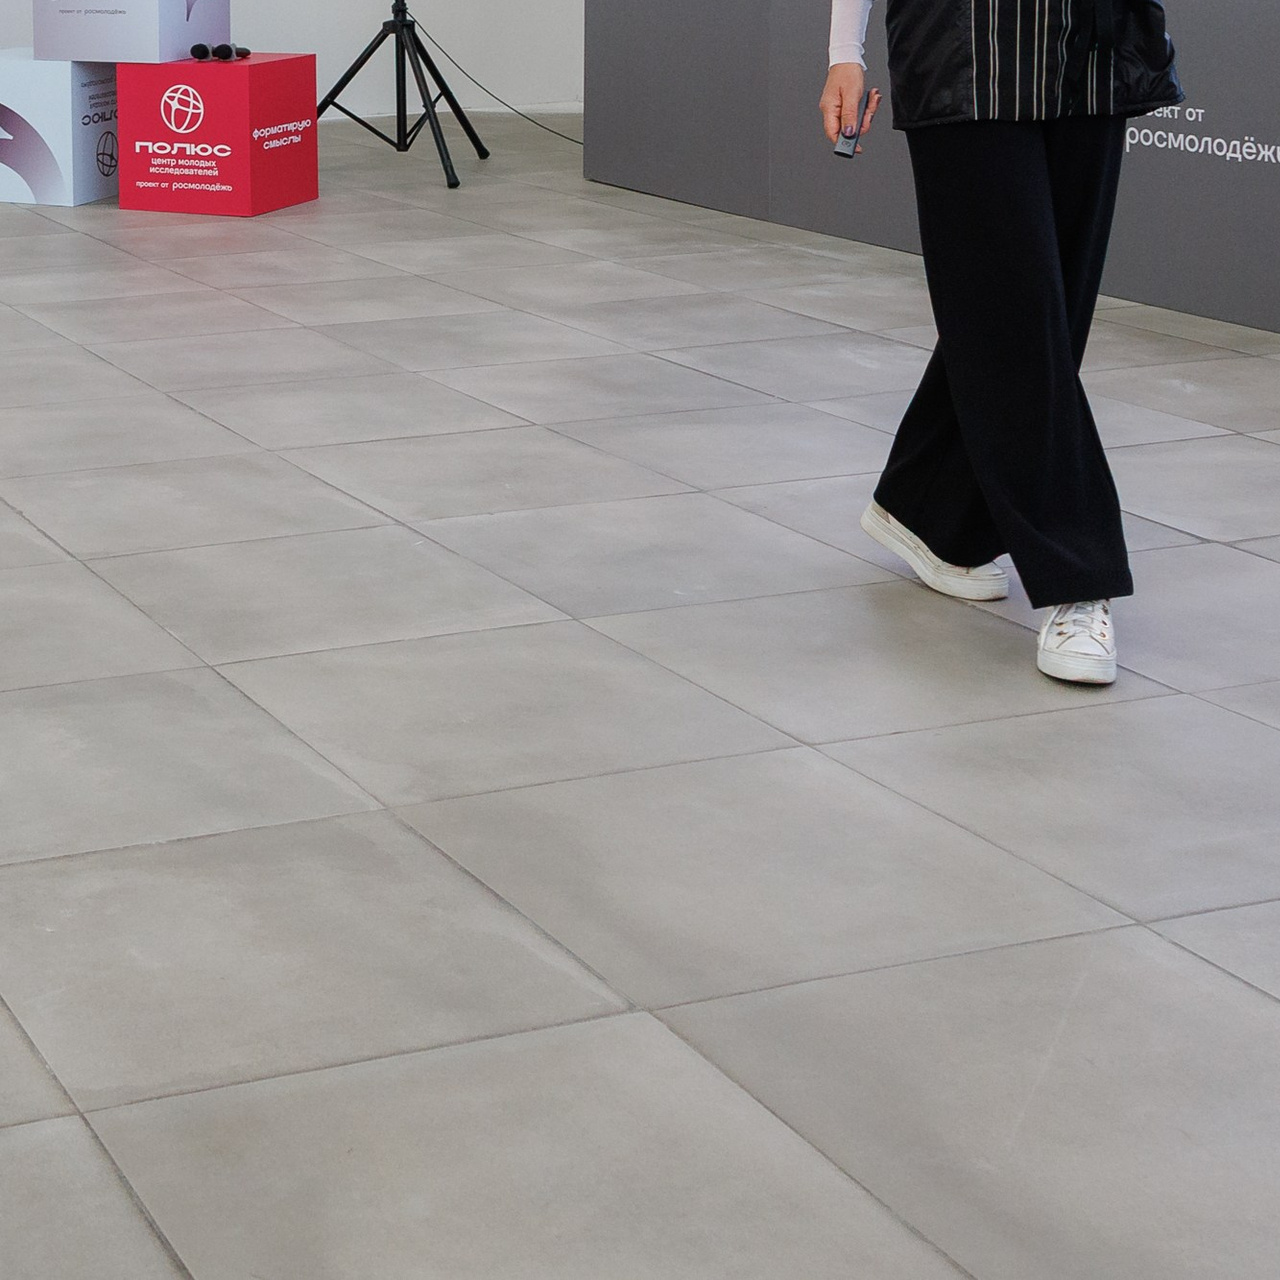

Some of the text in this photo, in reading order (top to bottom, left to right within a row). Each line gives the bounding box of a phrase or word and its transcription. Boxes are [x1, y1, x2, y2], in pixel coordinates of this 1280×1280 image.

[1134, 106, 1205, 122] ект от
[252, 118, 311, 140] форматирую
[263, 134, 301, 150] смыслы
[151, 158, 216, 167] центр молодых
[149, 166, 218, 176] исследователей
[136, 180, 159, 189] проект
[172, 181, 233, 192] росмолодёжь
